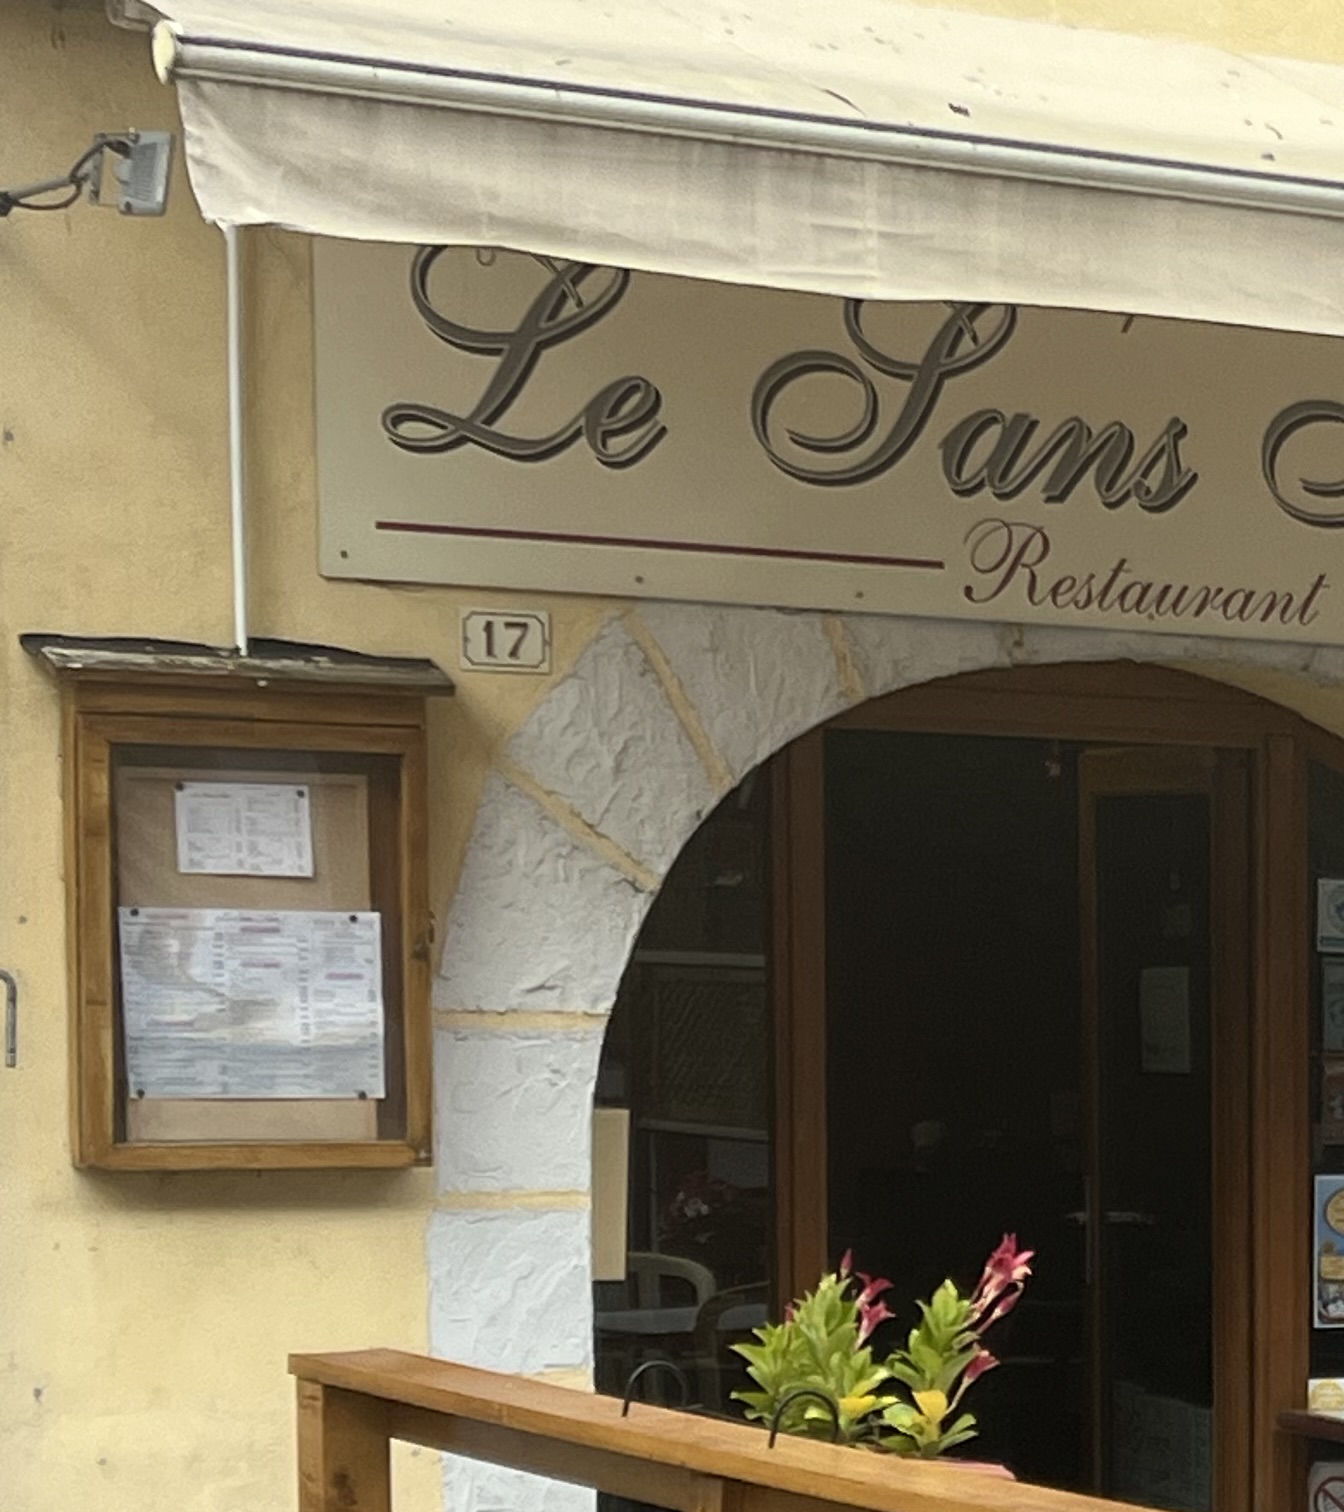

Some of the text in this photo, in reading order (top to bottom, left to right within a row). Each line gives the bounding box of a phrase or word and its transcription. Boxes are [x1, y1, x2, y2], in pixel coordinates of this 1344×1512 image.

[381, 245, 669, 470] Le
[752, 299, 1200, 514] Sans
[964, 517, 1330, 628] Restaurant
[480, 620, 530, 661] 17
